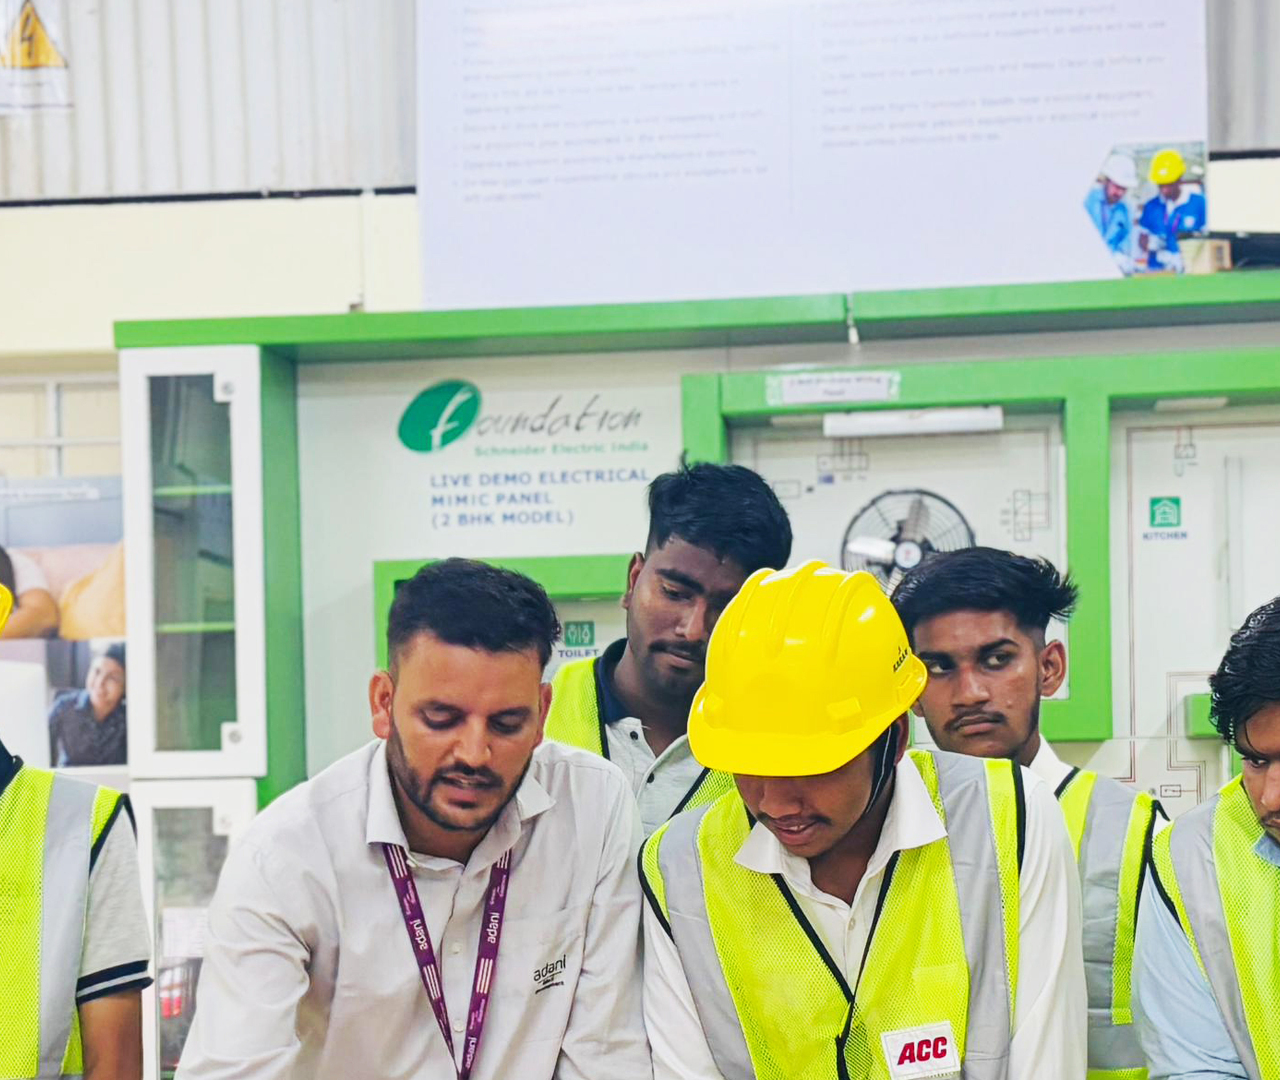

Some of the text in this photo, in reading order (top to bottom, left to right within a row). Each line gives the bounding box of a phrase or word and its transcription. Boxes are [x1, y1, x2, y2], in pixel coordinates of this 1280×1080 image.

[428, 385, 642, 452] foundation
[474, 440, 649, 458] Schneider Electric India
[430, 468, 651, 488] LIVE DEMO ELECTRICAL
[431, 491, 554, 507] MIMIC PANEL
[431, 510, 574, 529] (2 BHK MODEL)
[1142, 531, 1187, 540] KITCHEN
[558, 648, 599, 658] TOILET
[486, 911, 500, 945] adani
[532, 953, 567, 983] adani
[897, 1036, 948, 1066] ACC
